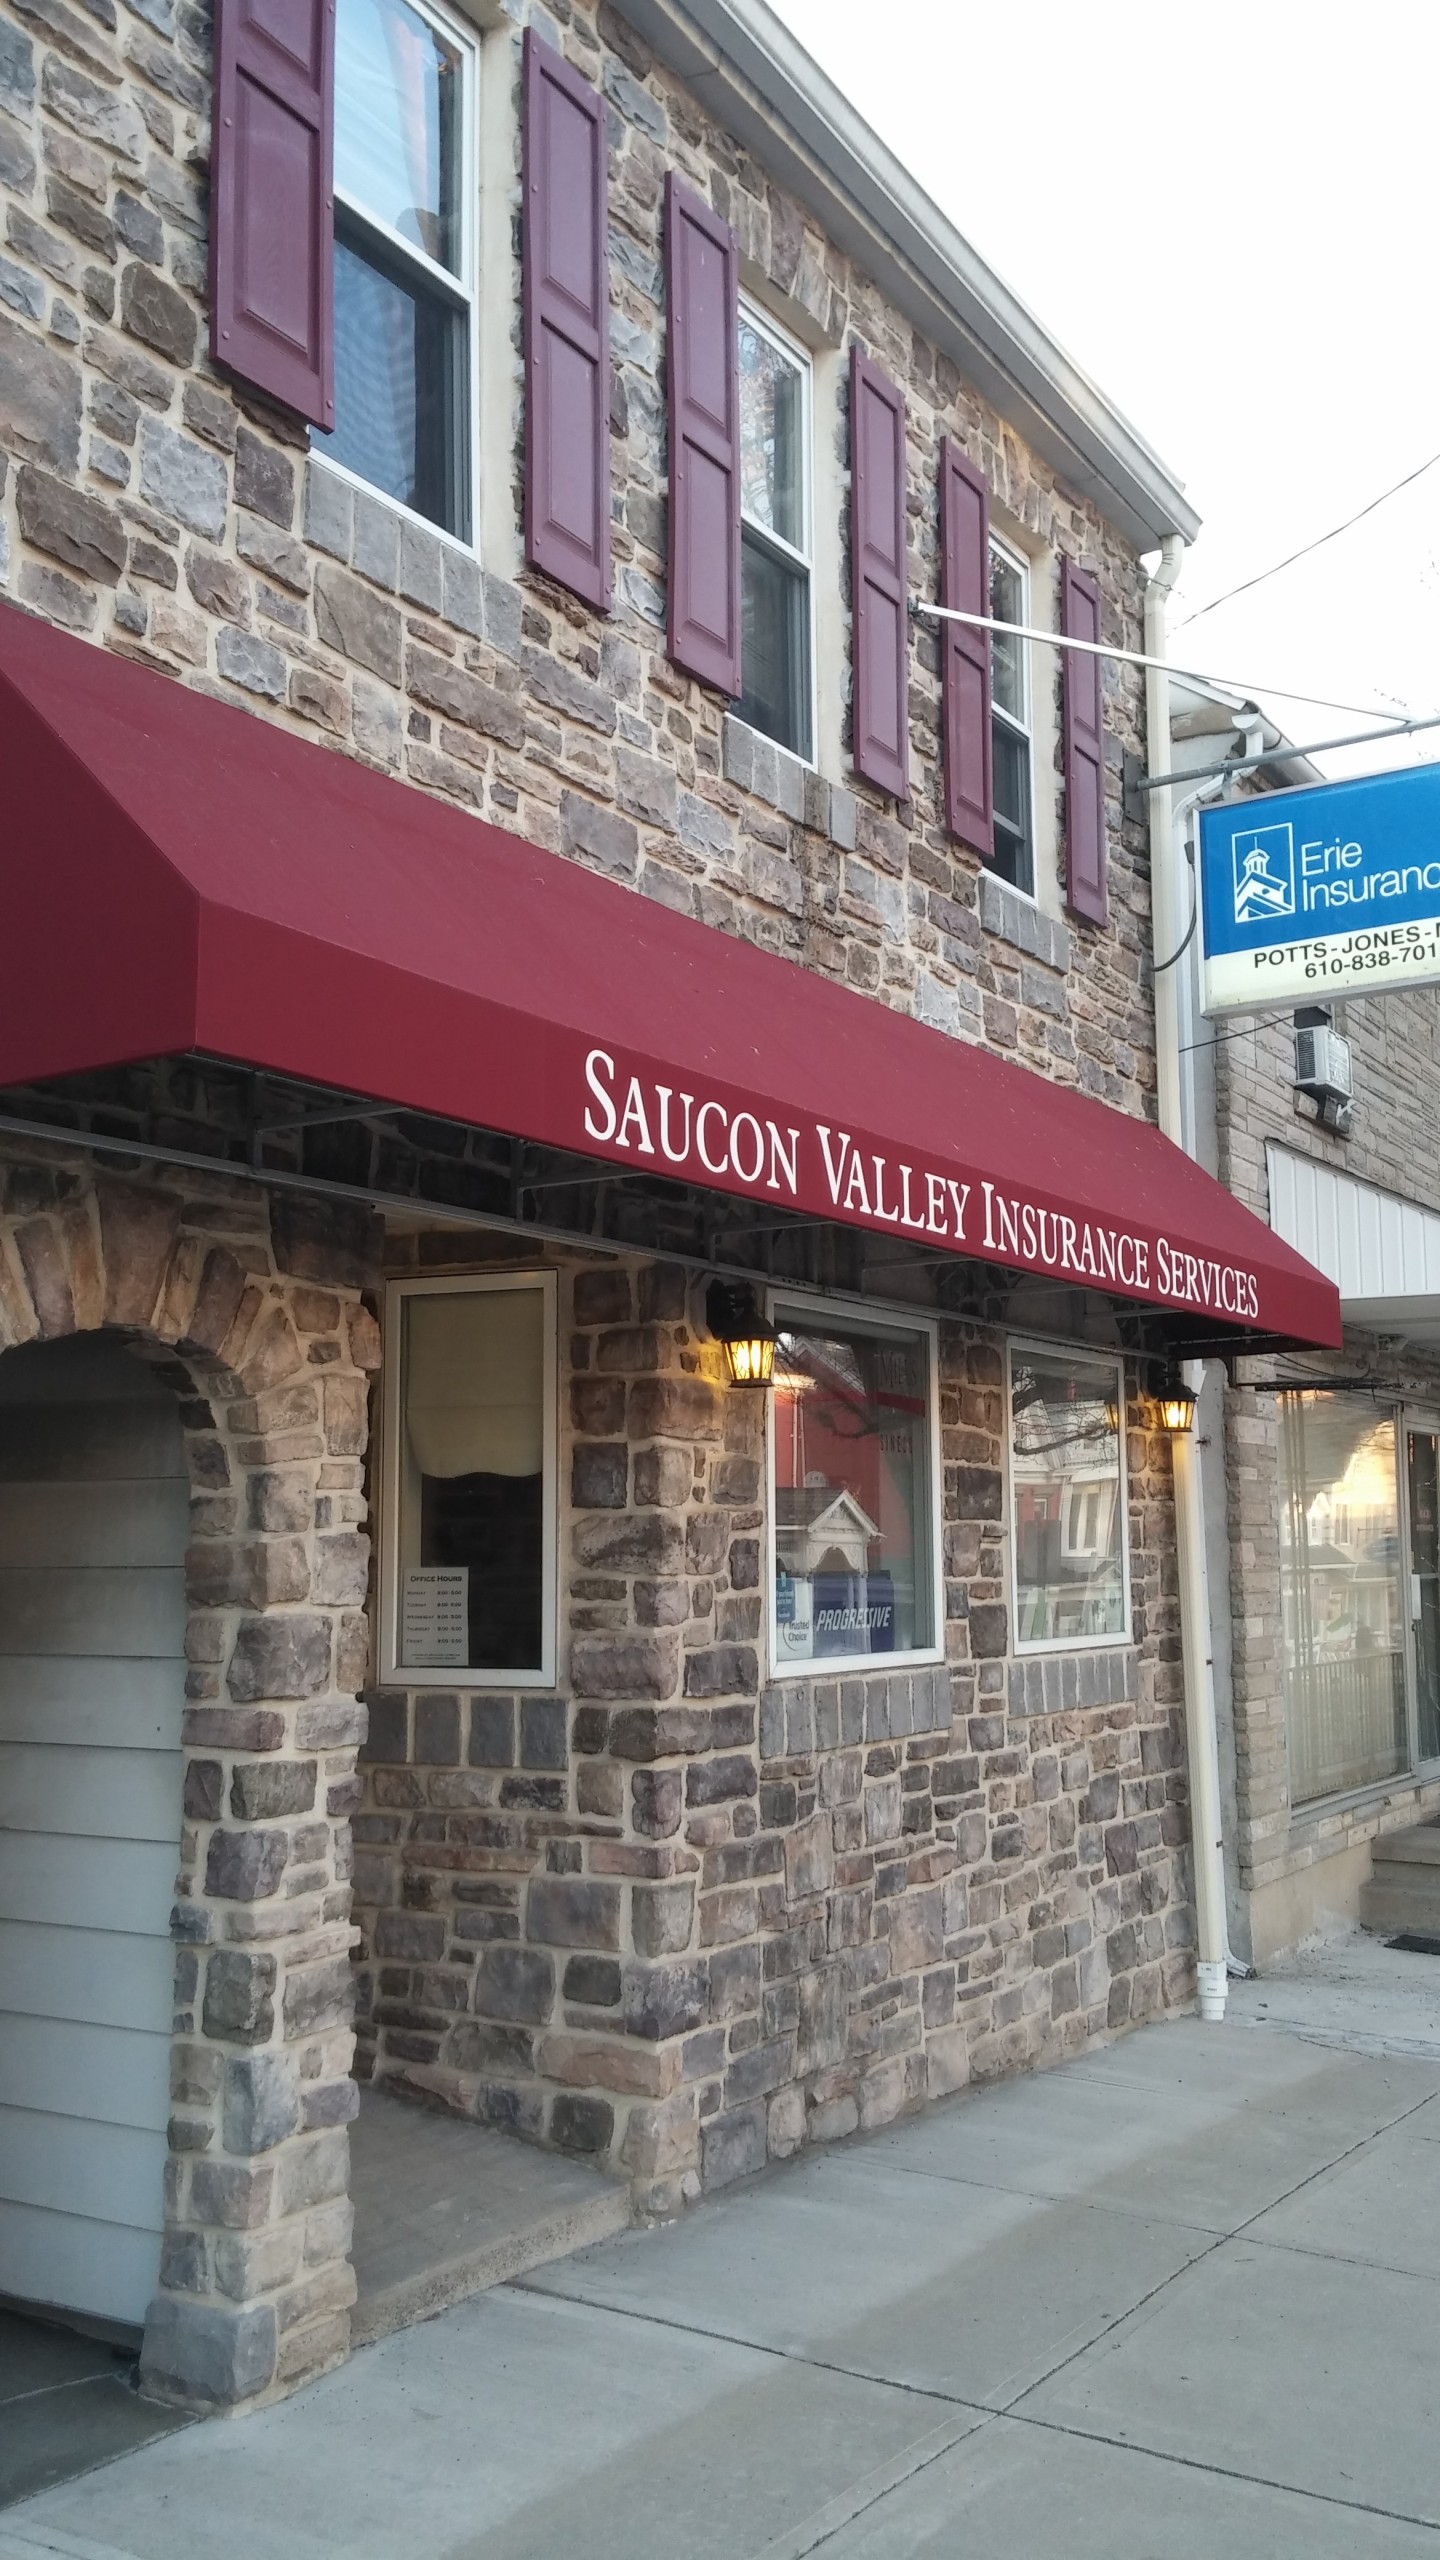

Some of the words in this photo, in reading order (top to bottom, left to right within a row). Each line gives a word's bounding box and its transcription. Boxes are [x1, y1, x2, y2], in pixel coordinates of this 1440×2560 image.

[1301, 838, 1362, 876] Erie
[1304, 942, 1436, 978] 610-838-701
[584, 1049, 800, 1195] SAUCON
[816, 1124, 970, 1240] VALLEY
[981, 1181, 1150, 1290] INSURANCE
[1157, 1237, 1259, 1319] SERVICES
[816, 1606, 892, 1631] PROGRESSIVE
[788, 1632, 807, 1642] Choice
